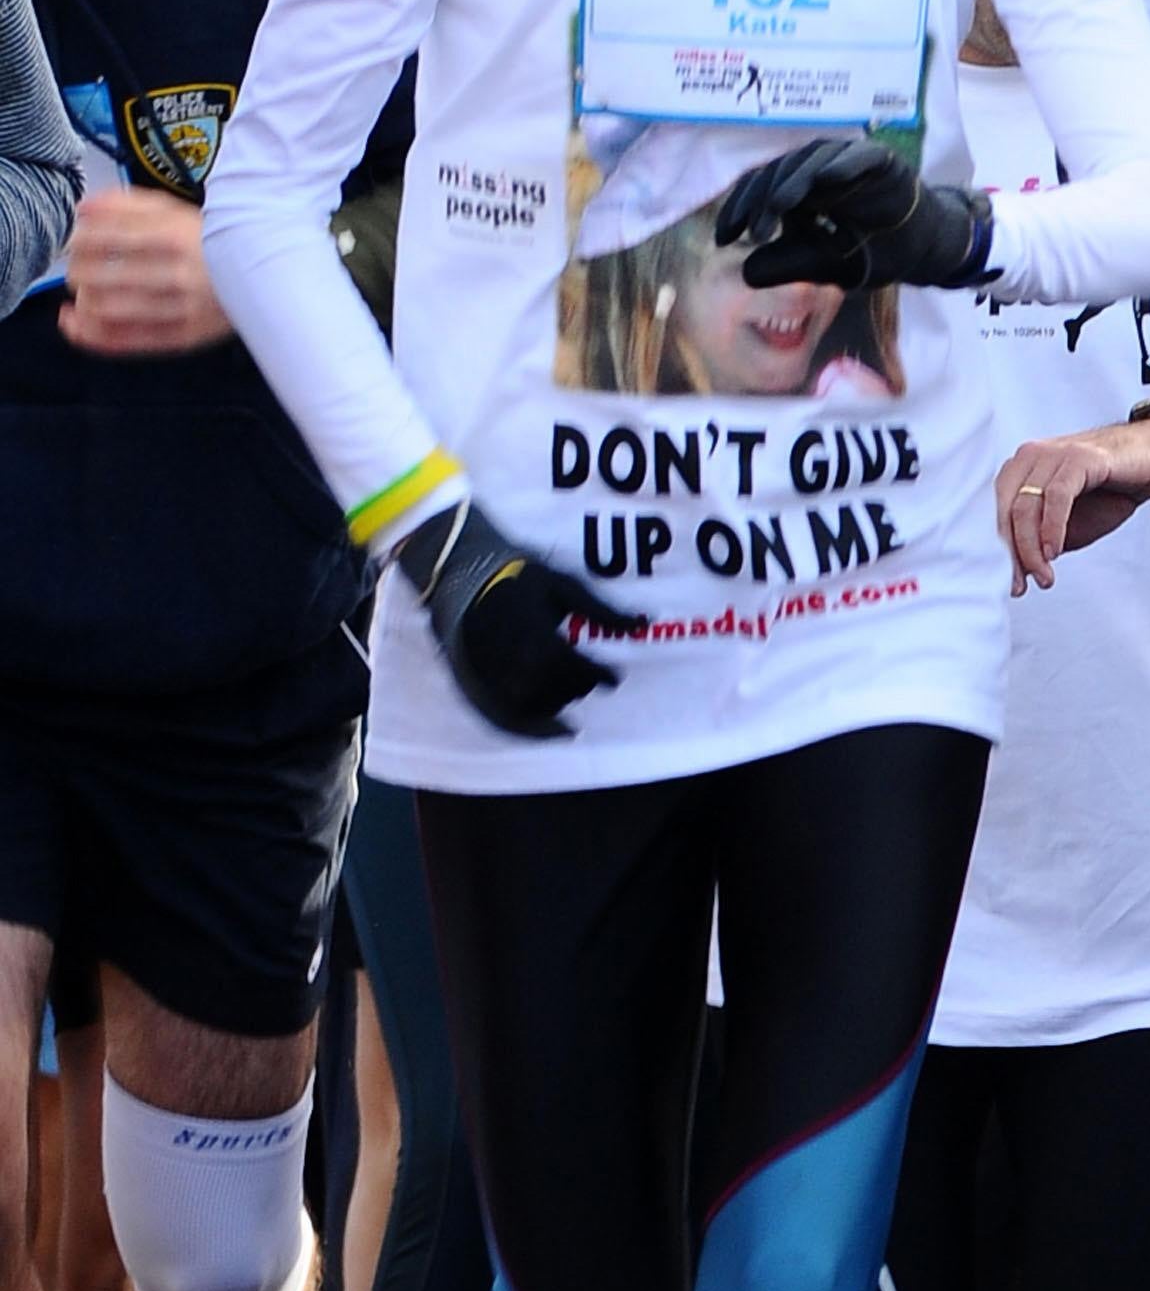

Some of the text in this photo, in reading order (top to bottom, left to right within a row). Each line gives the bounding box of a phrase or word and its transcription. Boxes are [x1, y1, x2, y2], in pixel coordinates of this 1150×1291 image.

[728, 12, 798, 35] Kate
[446, 196, 534, 227] people
[552, 420, 921, 497] DON'T GIVE
[583, 503, 905, 582] UP ON ME
